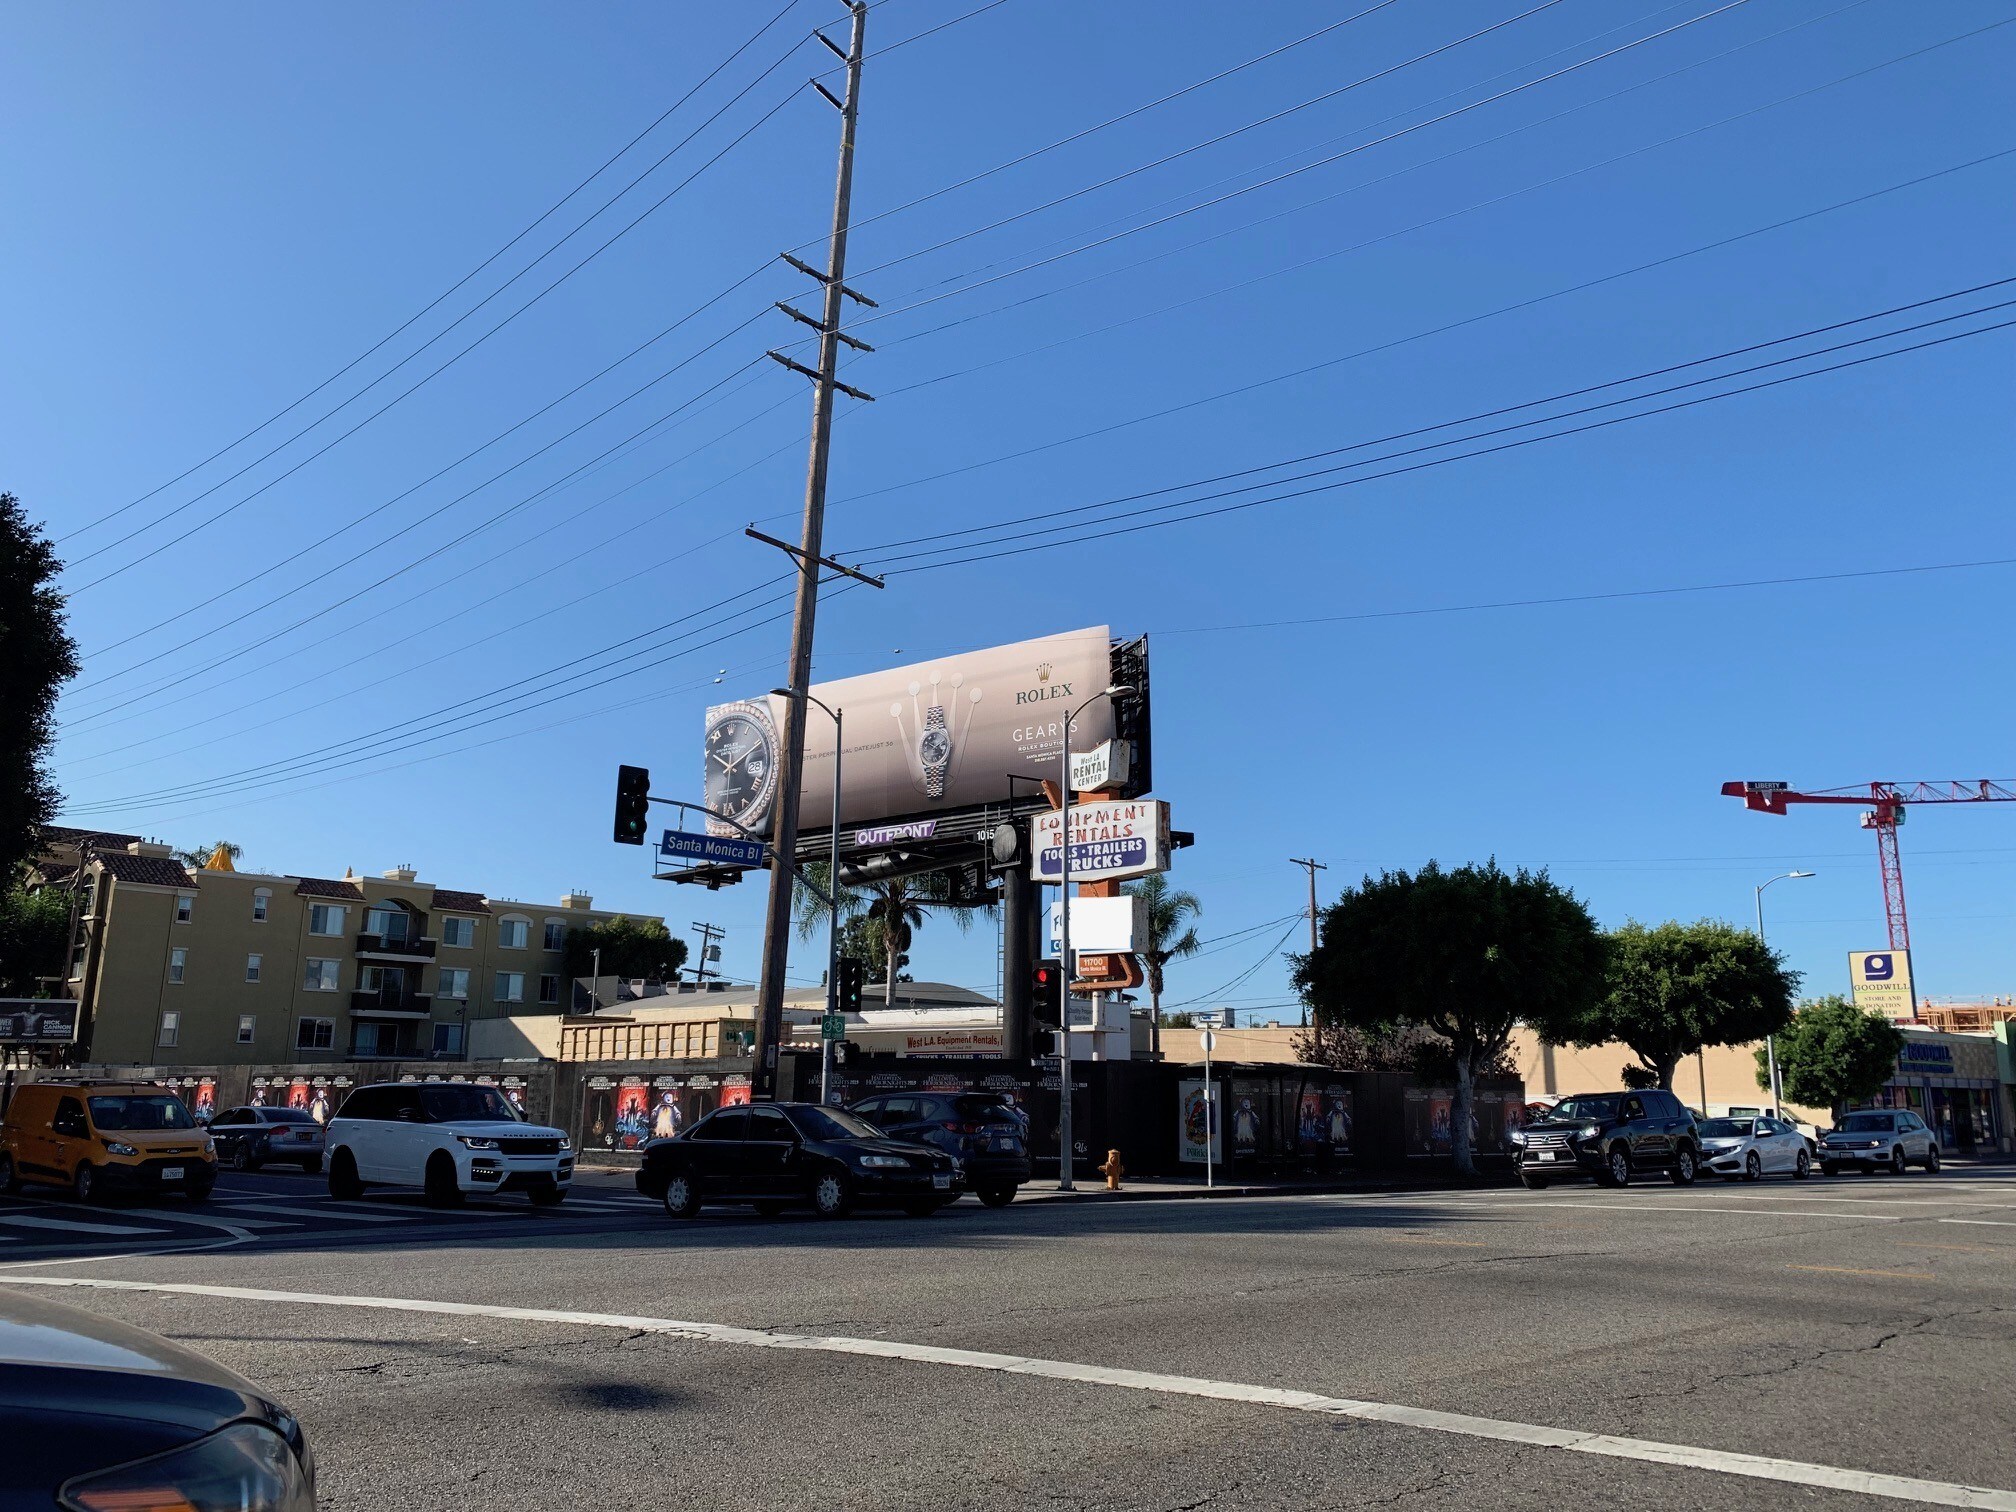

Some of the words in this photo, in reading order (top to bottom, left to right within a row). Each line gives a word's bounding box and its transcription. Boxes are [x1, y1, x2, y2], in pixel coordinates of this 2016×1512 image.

[1016, 683, 1073, 705] ROLEX
[854, 742, 884, 752] DATEJUST
[1039, 739, 1073, 749] BOUTIQE
[1080, 756, 1093, 765] West
[1093, 752, 1100, 762] LA
[748, 762, 762, 772] 28
[1073, 759, 1107, 779] RENTAL
[1077, 773, 1102, 787] CENTER
[1053, 823, 1133, 847] RENTALS
[668, 836, 701, 853] Santa
[705, 840, 744, 858] Monica
[747, 847, 759, 860] Bl
[1087, 839, 1143, 856] TRAILERS
[1067, 854, 1123, 871] RUCKS
[1084, 957, 1103, 966] 11700
[1853, 983, 1910, 991] GOODWILL
[907, 1036, 923, 1049] West
[924, 1036, 936, 1046] L.A.
[937, 1036, 971, 1046] Equipment
[973, 1035, 1000, 1047] Rentals,
